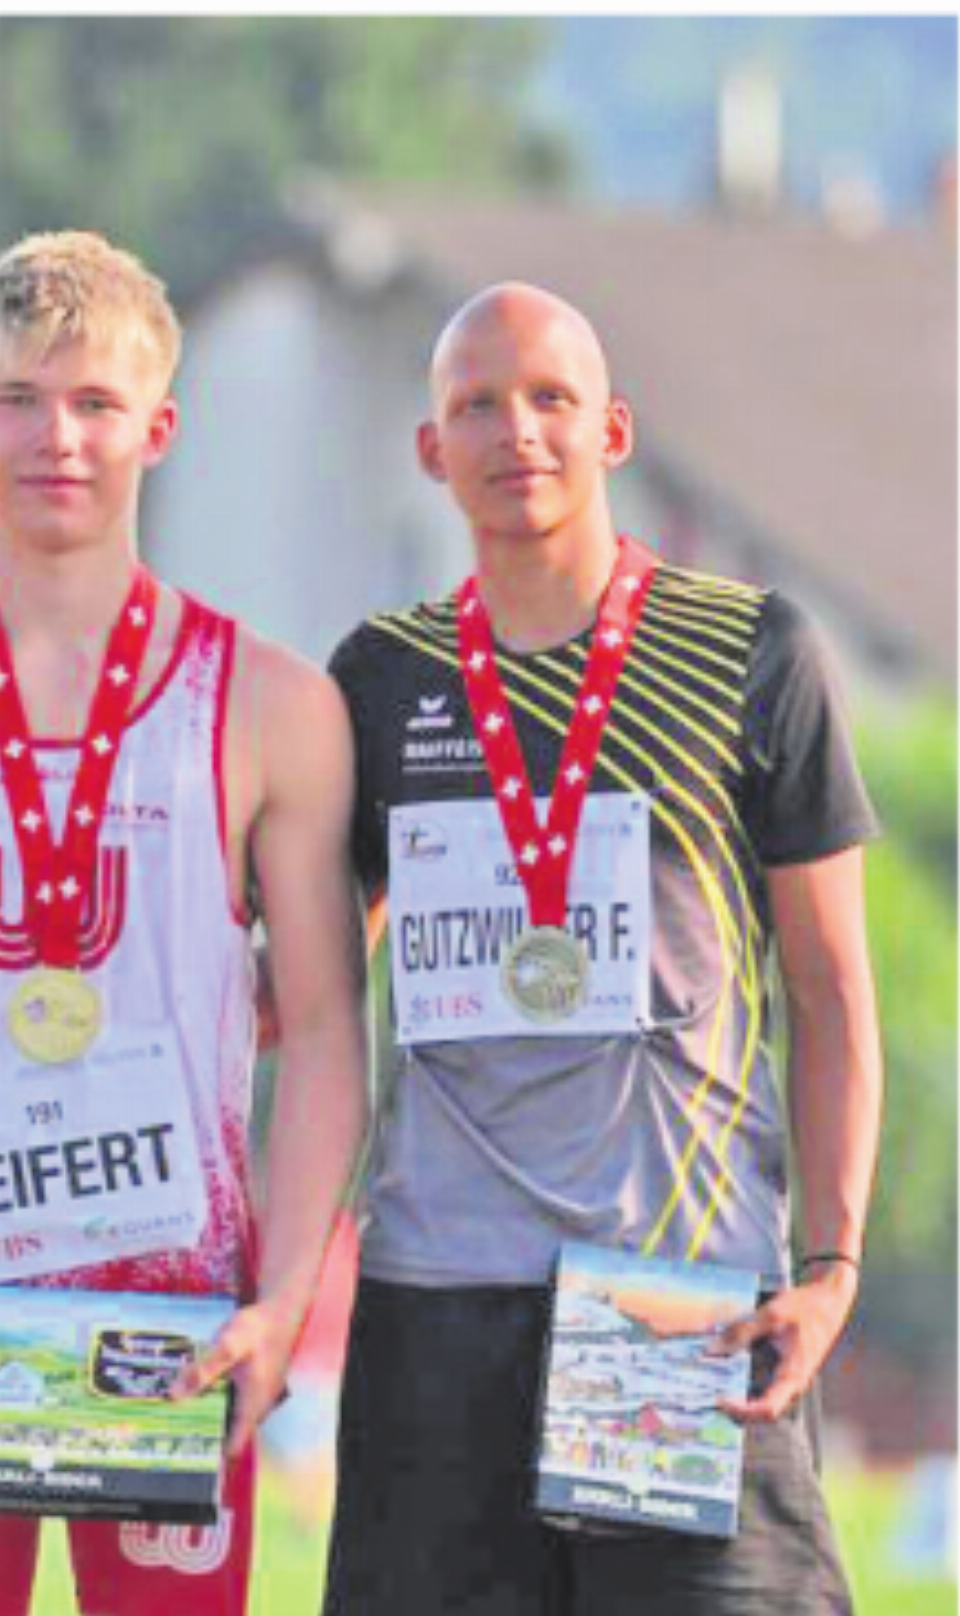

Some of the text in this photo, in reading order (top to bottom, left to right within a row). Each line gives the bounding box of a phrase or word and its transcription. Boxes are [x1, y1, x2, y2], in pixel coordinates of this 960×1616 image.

[401, 902, 637, 973] GUTZWIR F.
[24, 1100, 63, 1126] 191
